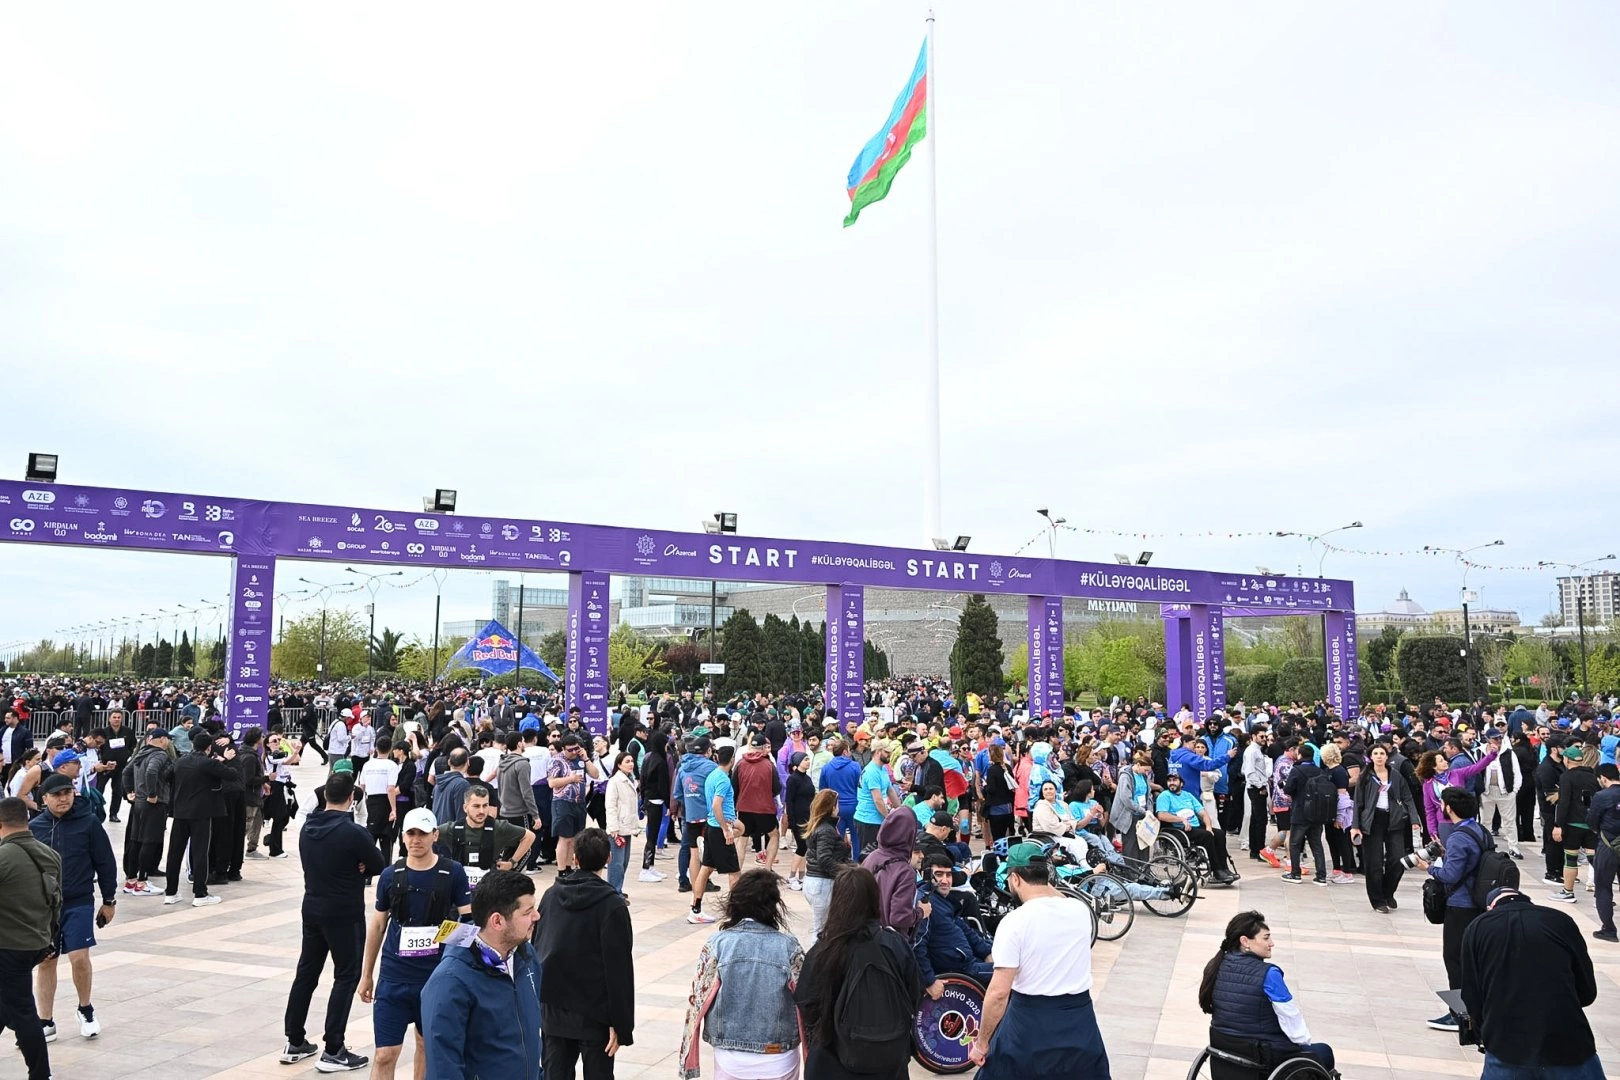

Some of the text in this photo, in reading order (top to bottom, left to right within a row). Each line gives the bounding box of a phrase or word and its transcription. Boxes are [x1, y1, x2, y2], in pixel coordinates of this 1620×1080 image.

[28, 492, 50, 501] AZE
[10, 518, 35, 531] GO
[312, 516, 338, 524] BREEZE
[418, 520, 434, 528] AZE
[406, 543, 425, 554] GO
[525, 552, 539, 560] TAN
[708, 544, 798, 568] START
[811, 554, 896, 571] #KÜLƏYƏQALİBGƏL
[906, 558, 980, 581] START
[1080, 570, 1191, 592] #KÜLƏYƏQALİBGƏL
[1088, 600, 1138, 612] MEYDANI
[472, 648, 497, 661] Red
[830, 618, 838, 711] ƏYƏQALİBGƏL
[1331, 636, 1342, 719] ÜLƏYƏQALİBGƏL
[407, 938, 432, 948] 3133
[966, 998, 980, 1015] 2020
